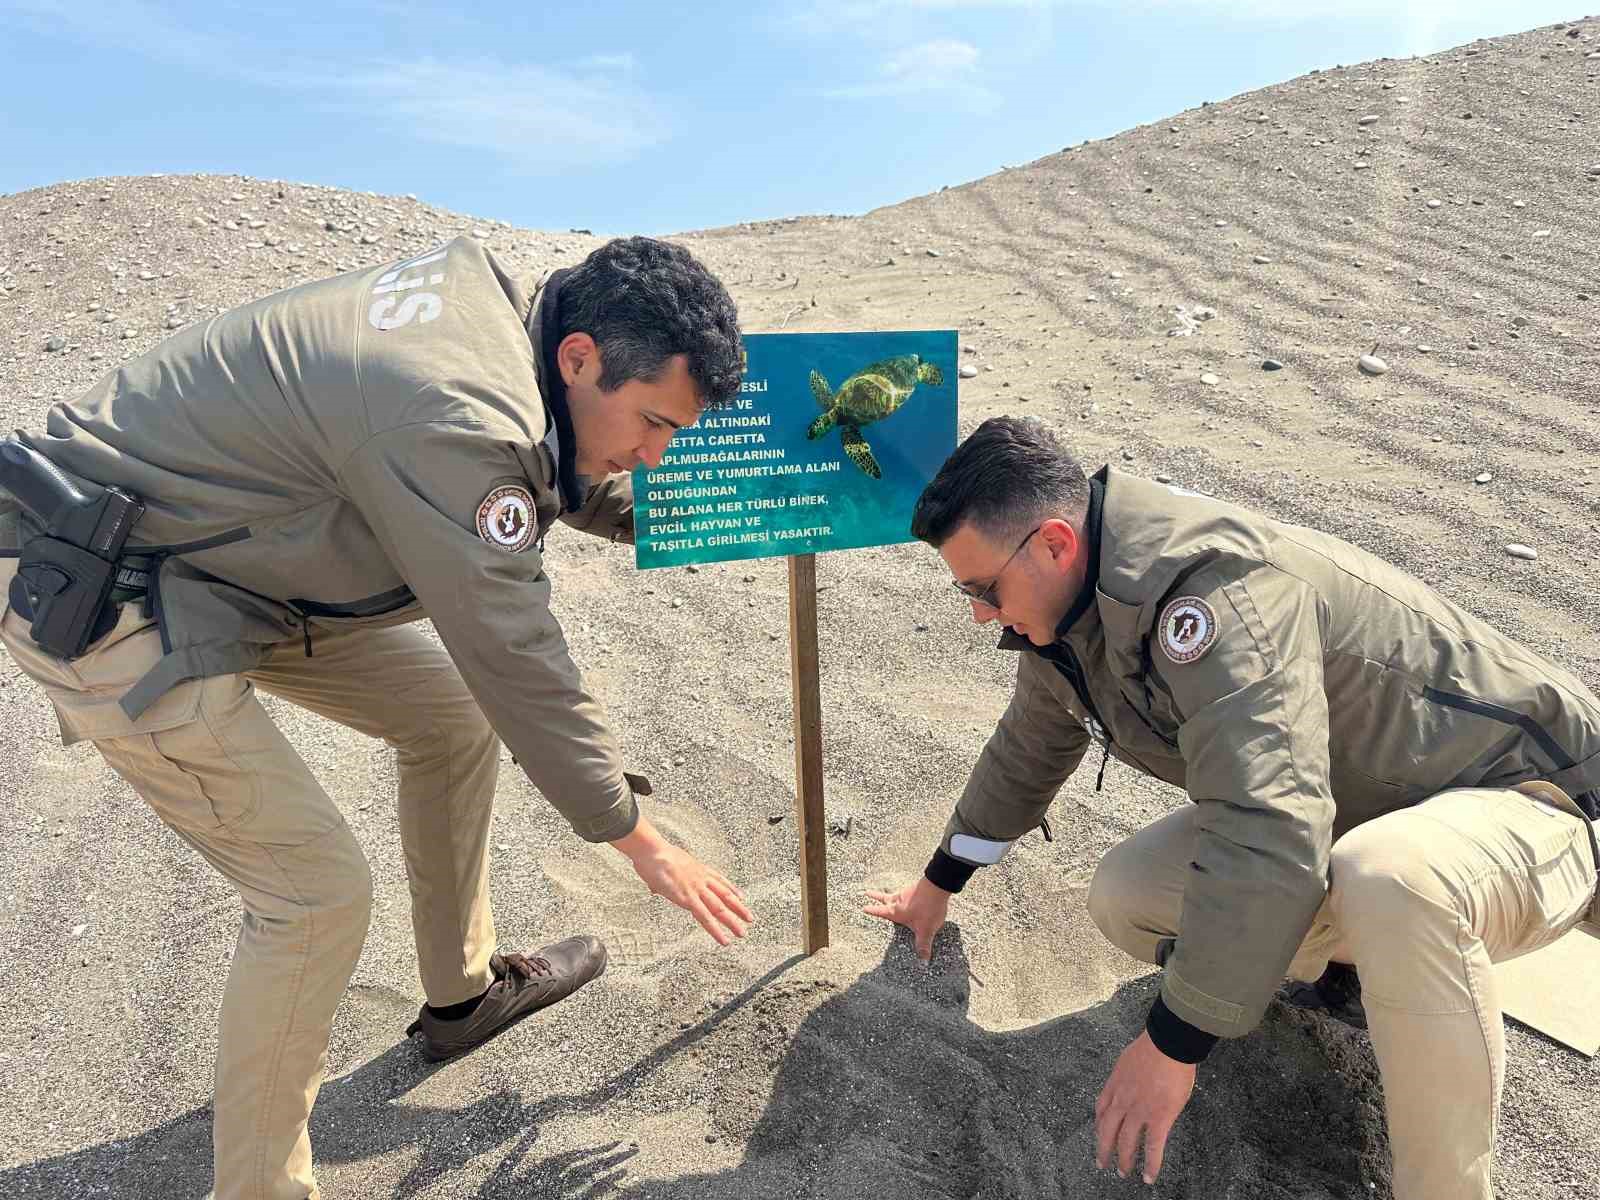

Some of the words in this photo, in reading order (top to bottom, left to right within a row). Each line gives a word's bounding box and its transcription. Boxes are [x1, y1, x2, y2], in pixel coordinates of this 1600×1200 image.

[736, 399, 752, 410] VE
[705, 414, 770, 427] ALTINDAKİ
[709, 433, 765, 446] CARETTA
[658, 449, 785, 465] APLMUBAĞALARININ
[647, 472, 692, 484] ÜREME
[696, 470, 713, 481] VE
[717, 464, 802, 479] YUMURTLAMA
[805, 462, 840, 473] ALANI
[648, 485, 737, 501] OLDUĞUNDAN
[649, 507, 667, 518] BU
[671, 504, 713, 517] ALANA
[717, 502, 742, 513] HER
[747, 497, 785, 510] TÜRLÜ
[790, 494, 829, 507] BİNEK,
[650, 521, 687, 535] EVCİL
[691, 519, 741, 532] HAYVAN
[745, 517, 761, 527] VE
[650, 540, 704, 553] TAŞITLA
[708, 530, 769, 546] GİRİLMESİ
[773, 526, 834, 540] YASAKTIR.
